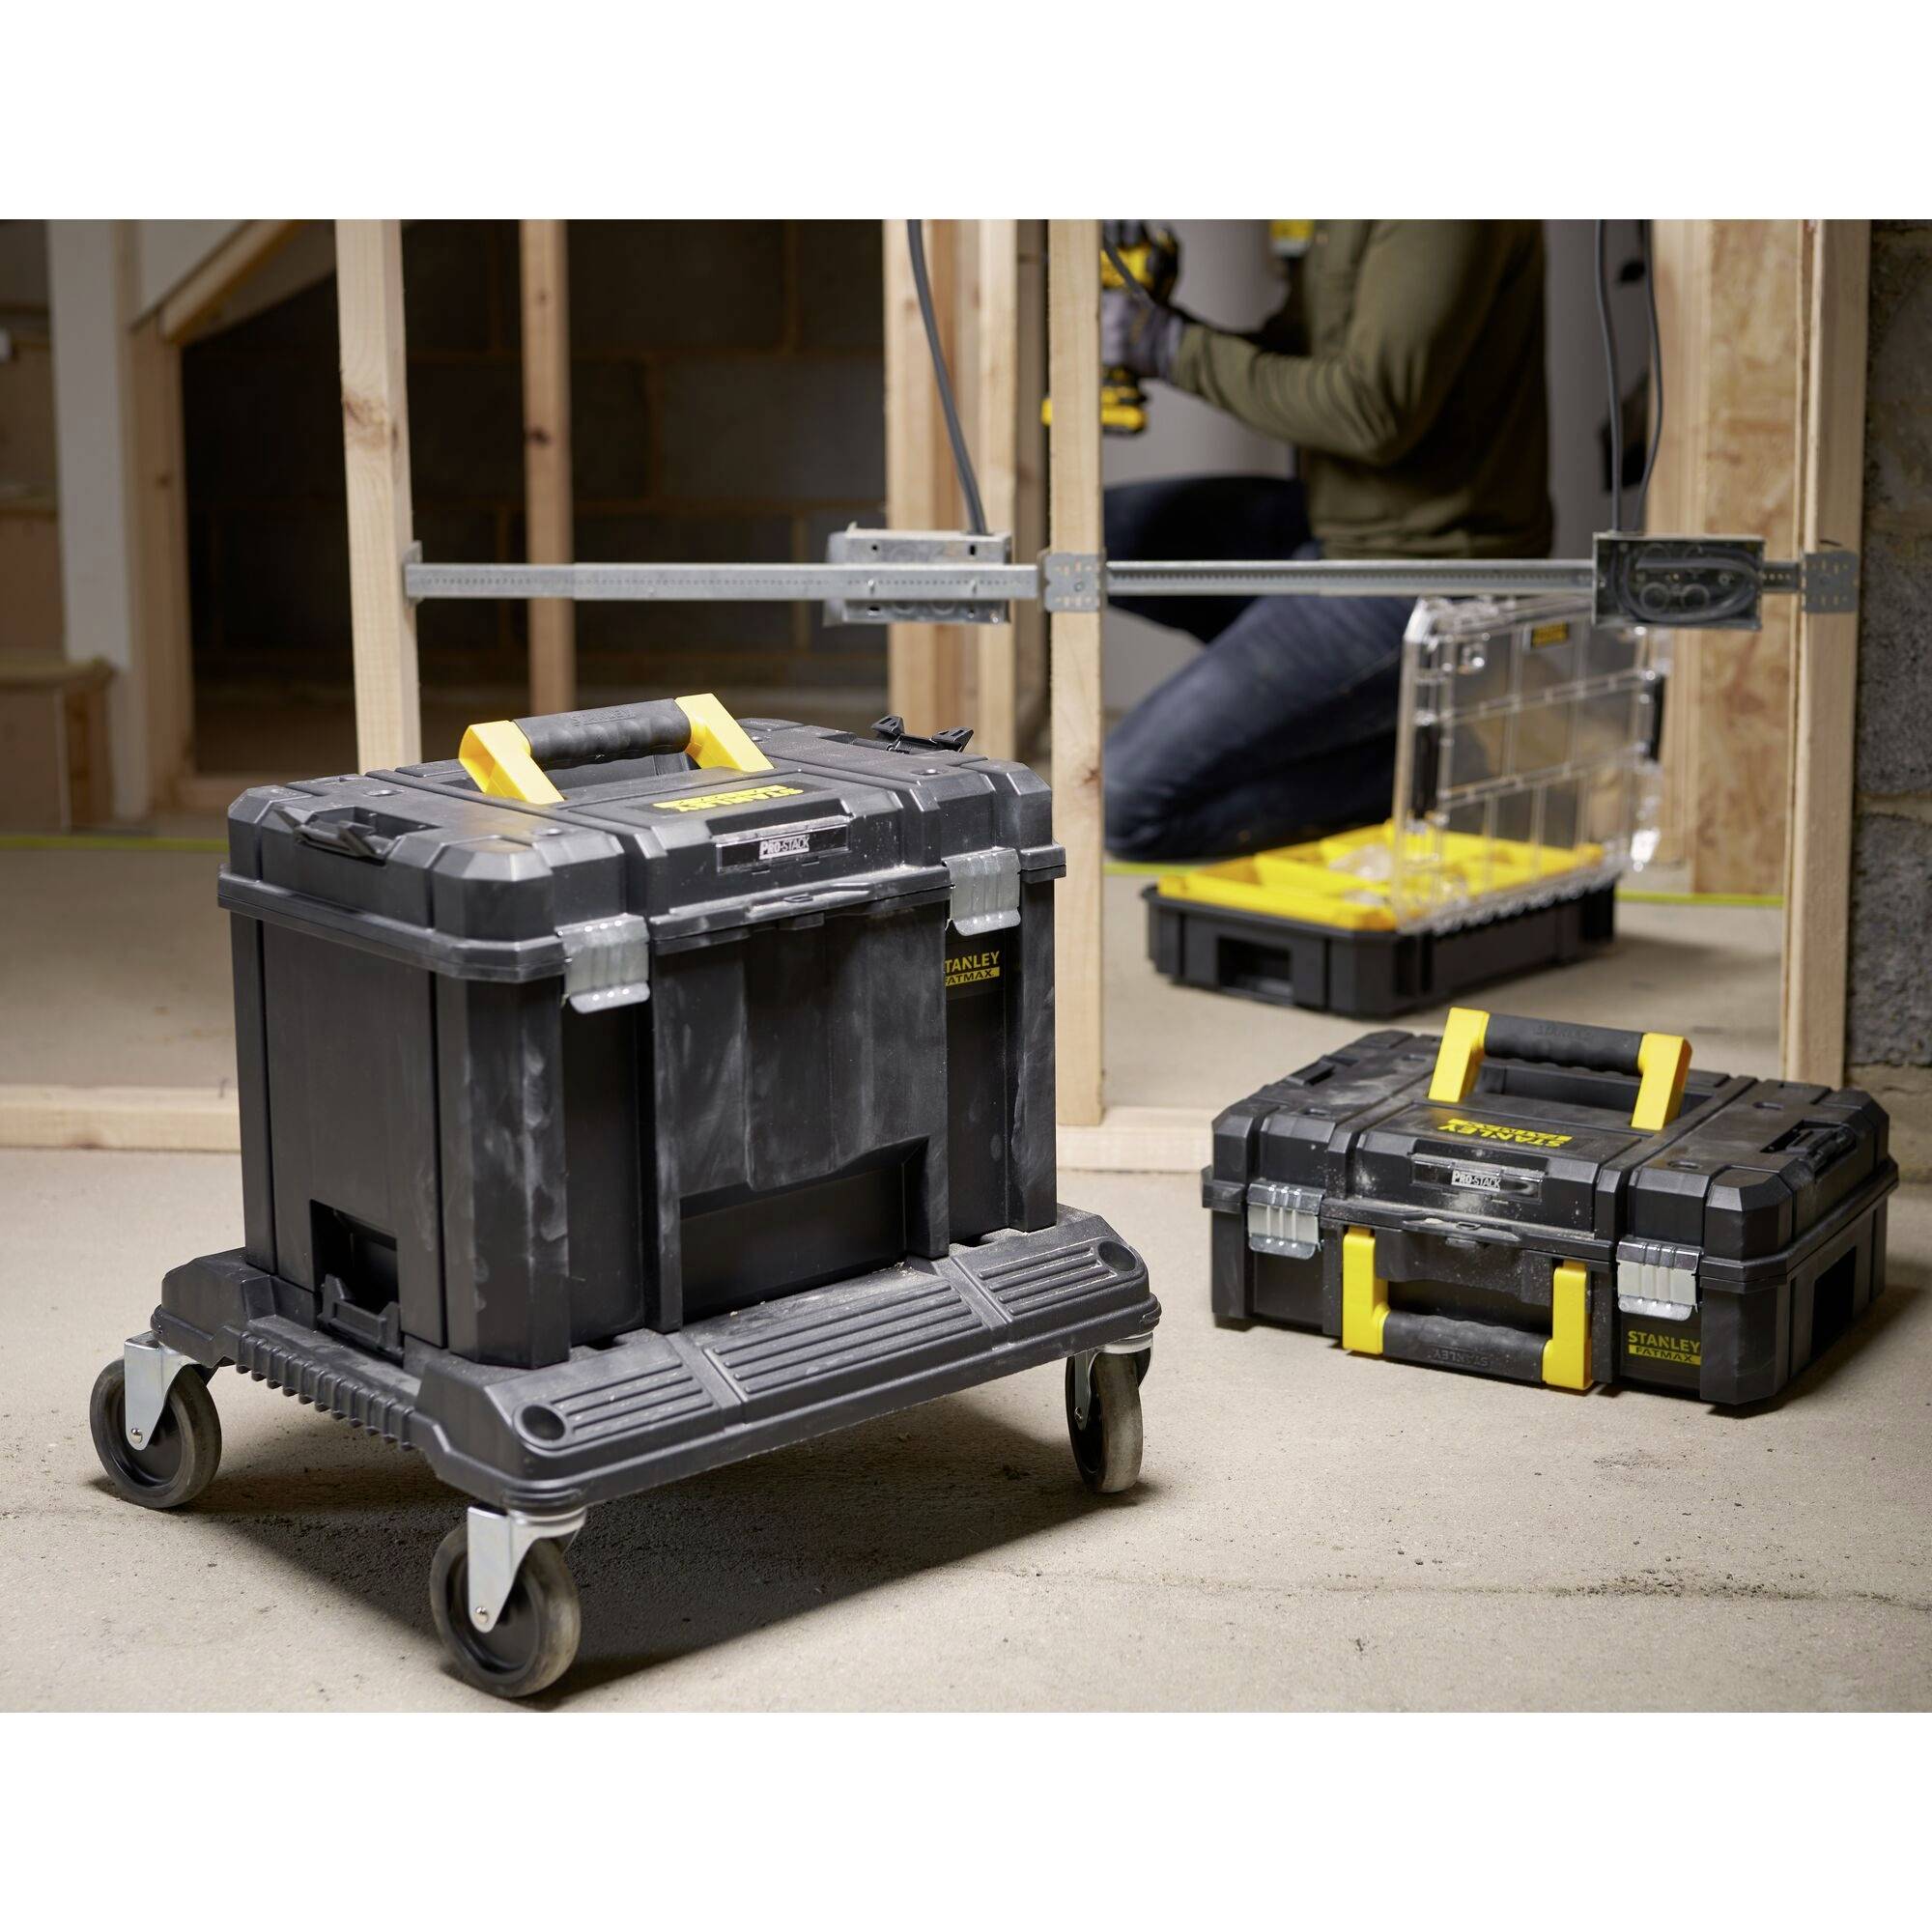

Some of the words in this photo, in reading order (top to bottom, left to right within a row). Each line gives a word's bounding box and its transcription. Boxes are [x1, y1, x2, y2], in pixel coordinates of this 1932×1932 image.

[759, 835, 810, 857] PRO-STACK
[944, 951, 1000, 974] TANLEY
[945, 969, 992, 984] ATMAX
[1452, 1169, 1501, 1189] PRO-STACK
[1628, 1330, 1700, 1353] STANLEY
[1635, 1346, 1692, 1363] FATMAX
